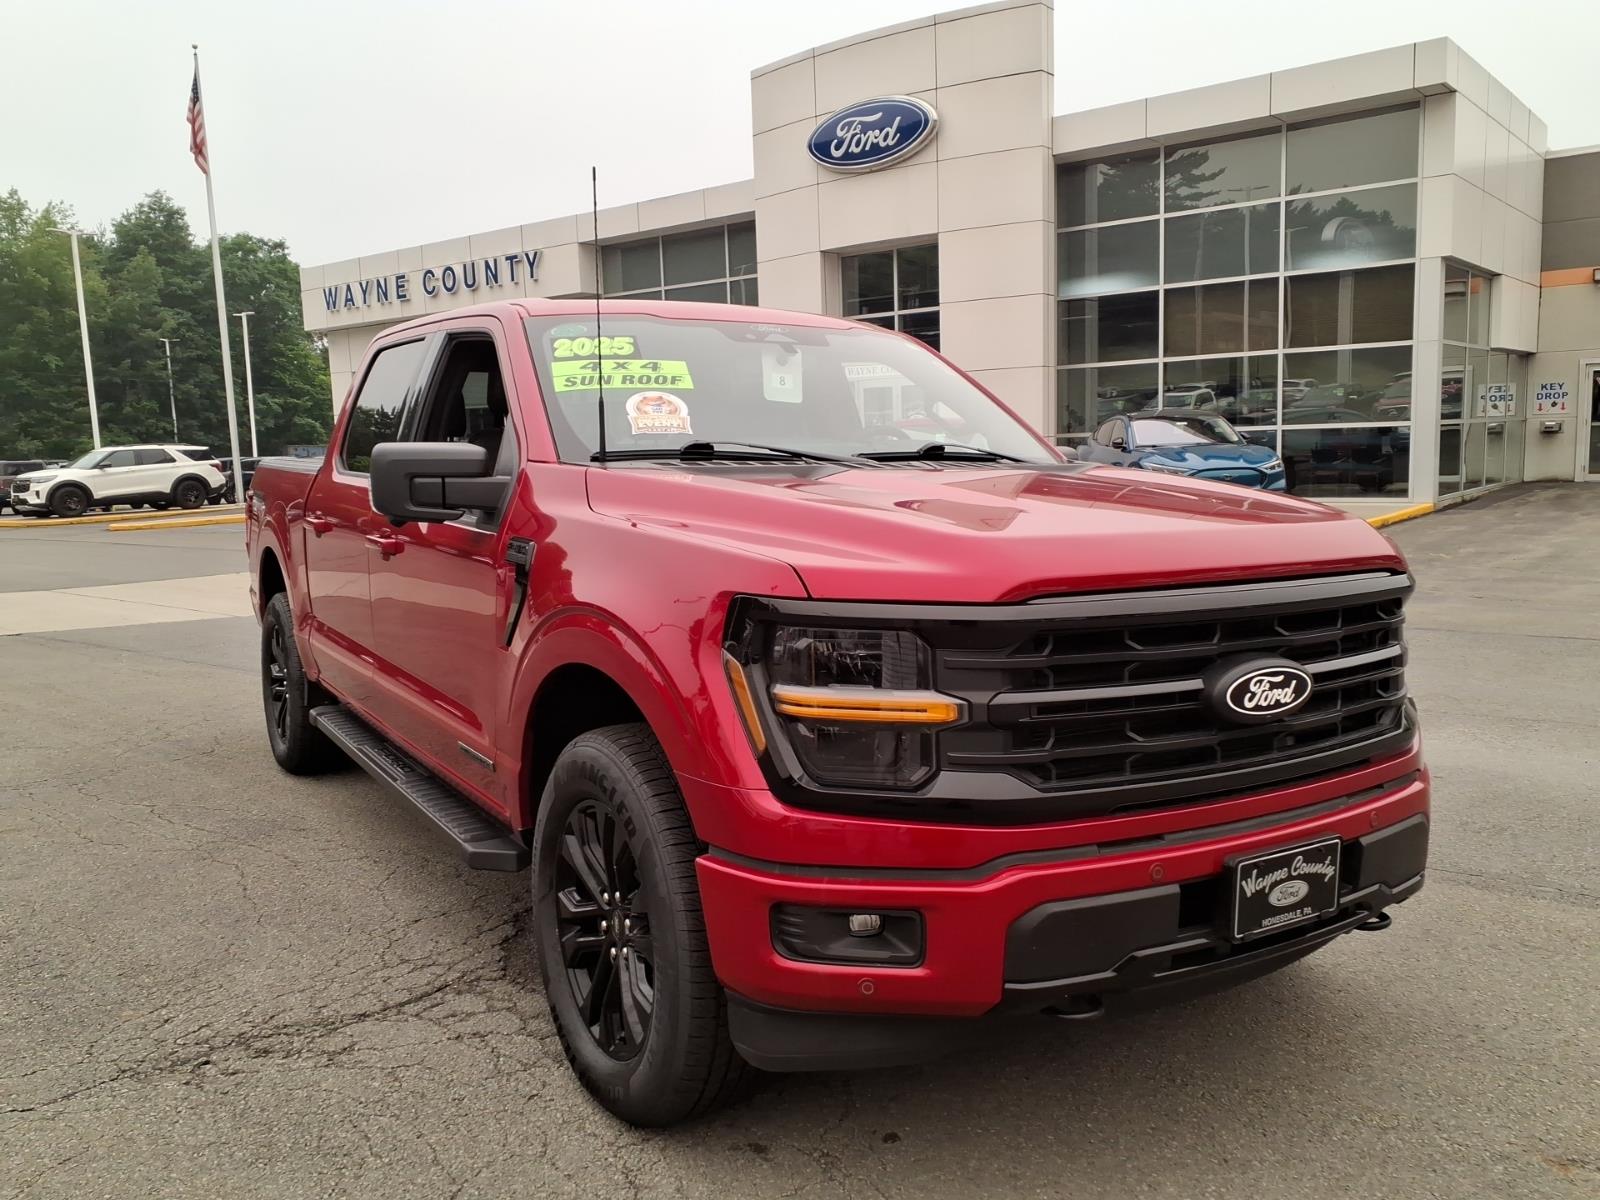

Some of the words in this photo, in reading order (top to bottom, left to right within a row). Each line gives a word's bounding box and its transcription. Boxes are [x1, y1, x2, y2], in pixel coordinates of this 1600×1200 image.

[830, 112, 901, 158] Ford
[323, 275, 409, 312] WAYNE
[423, 251, 541, 297] COUNTY
[553, 337, 635, 358] 2025
[579, 361, 601, 372] 4
[639, 361, 661, 372] 4
[563, 375, 613, 387] SUN
[620, 375, 683, 385] ROOF
[778, 376, 786, 386] 8
[1540, 382, 1565, 391] KEY
[1536, 391, 1569, 401] DROP
[1244, 675, 1297, 708] Ford
[1241, 868, 1288, 898] Wayne
[1290, 856, 1335, 882] County
[1277, 885, 1300, 902] Ford
